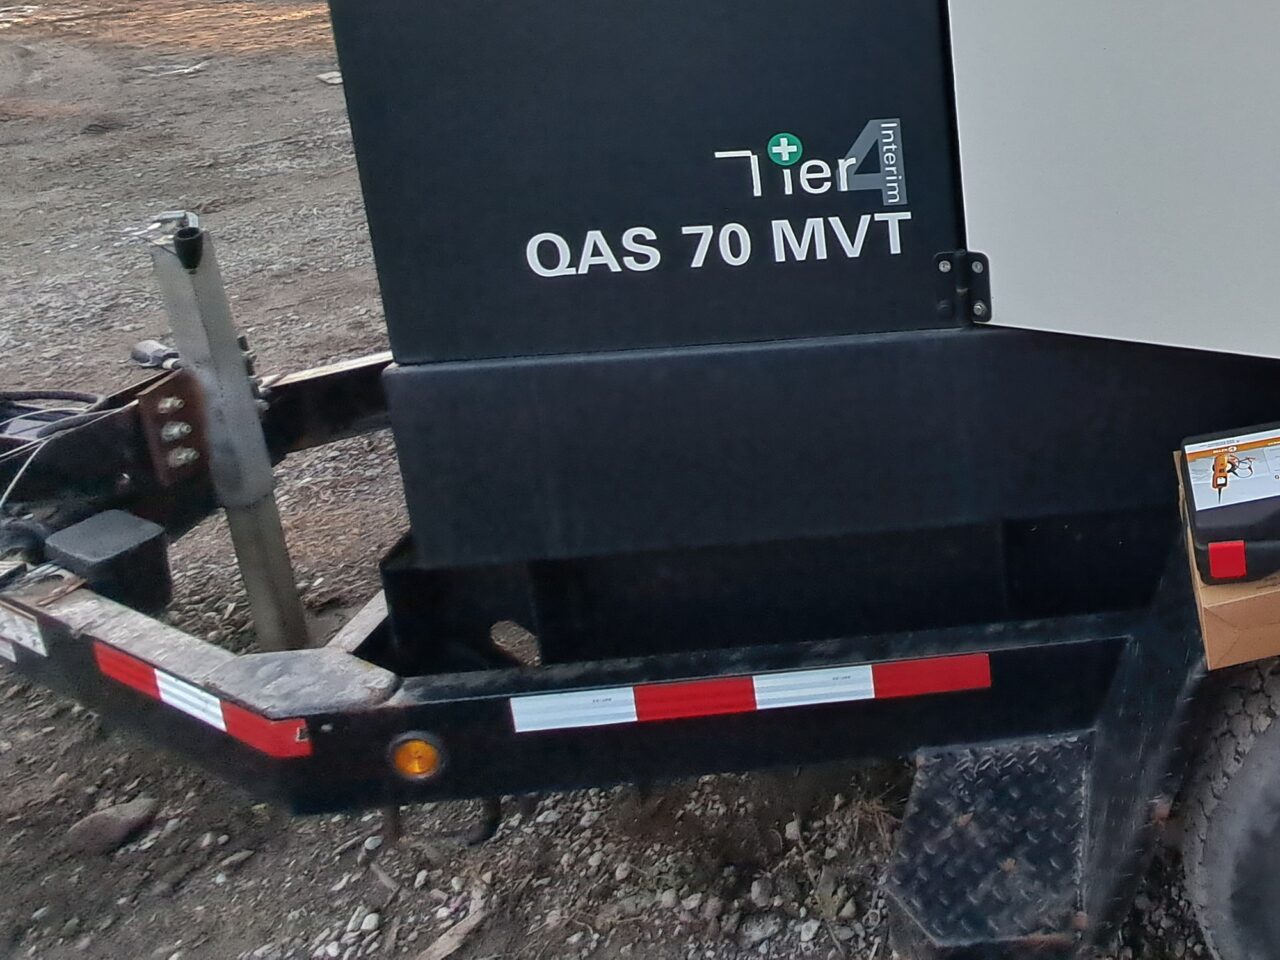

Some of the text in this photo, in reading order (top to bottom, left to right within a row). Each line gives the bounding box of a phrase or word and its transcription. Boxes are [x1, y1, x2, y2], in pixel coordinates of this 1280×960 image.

[714, 140, 857, 197] Tier
[880, 121, 902, 204] Interim
[526, 211, 912, 277] QAS 70 MVT
